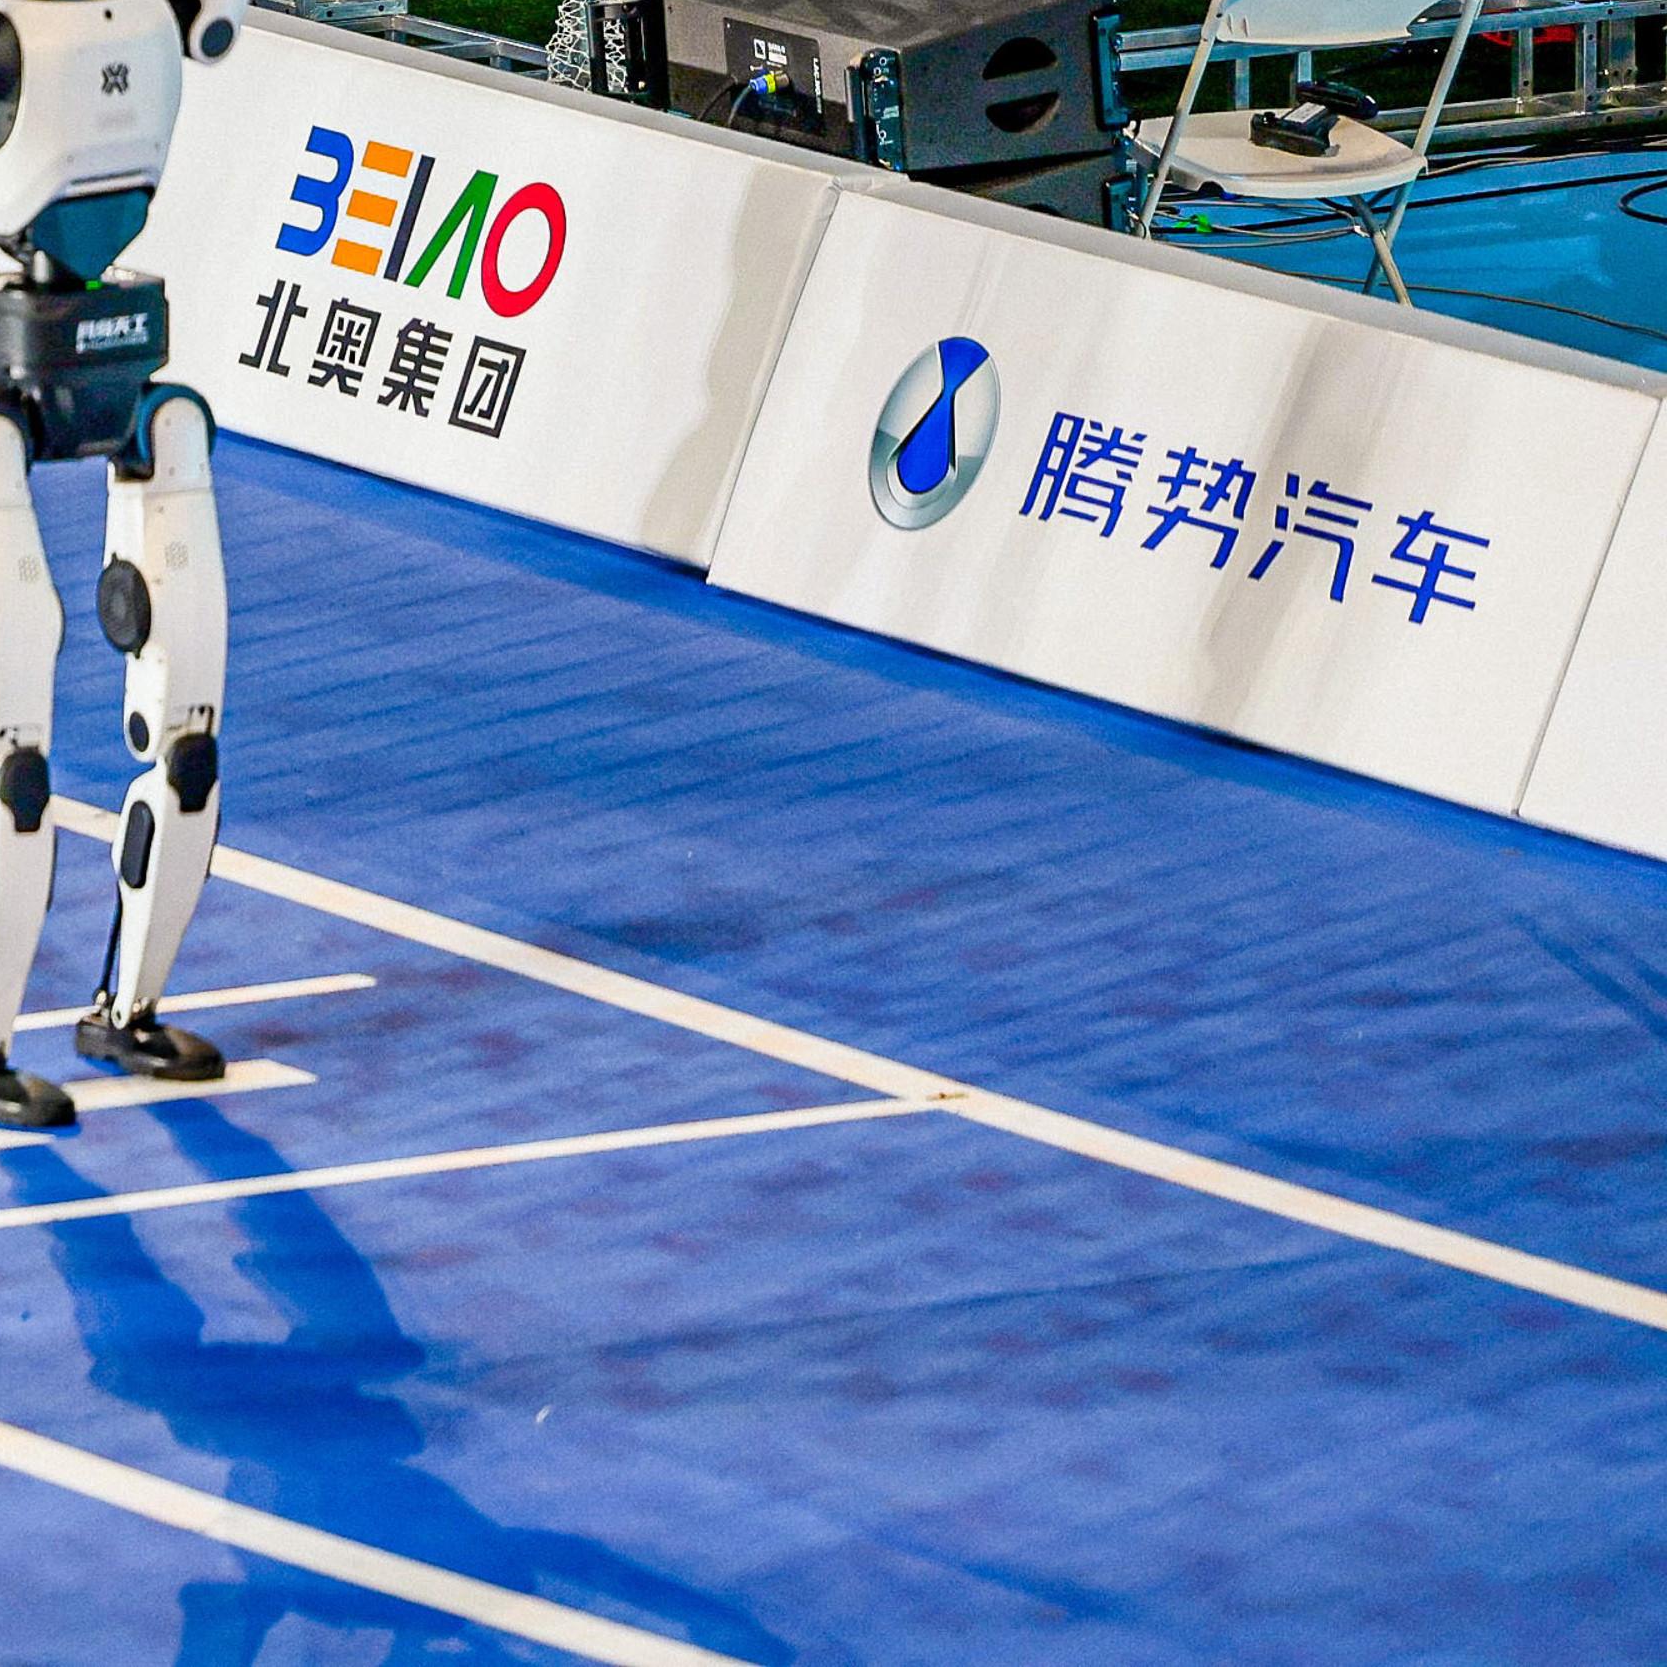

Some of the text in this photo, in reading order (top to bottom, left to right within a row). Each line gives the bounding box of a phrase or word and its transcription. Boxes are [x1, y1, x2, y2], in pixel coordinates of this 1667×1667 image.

[238, 277, 528, 440] 北奥集团
[1019, 410, 1491, 625] 腾势汽车
